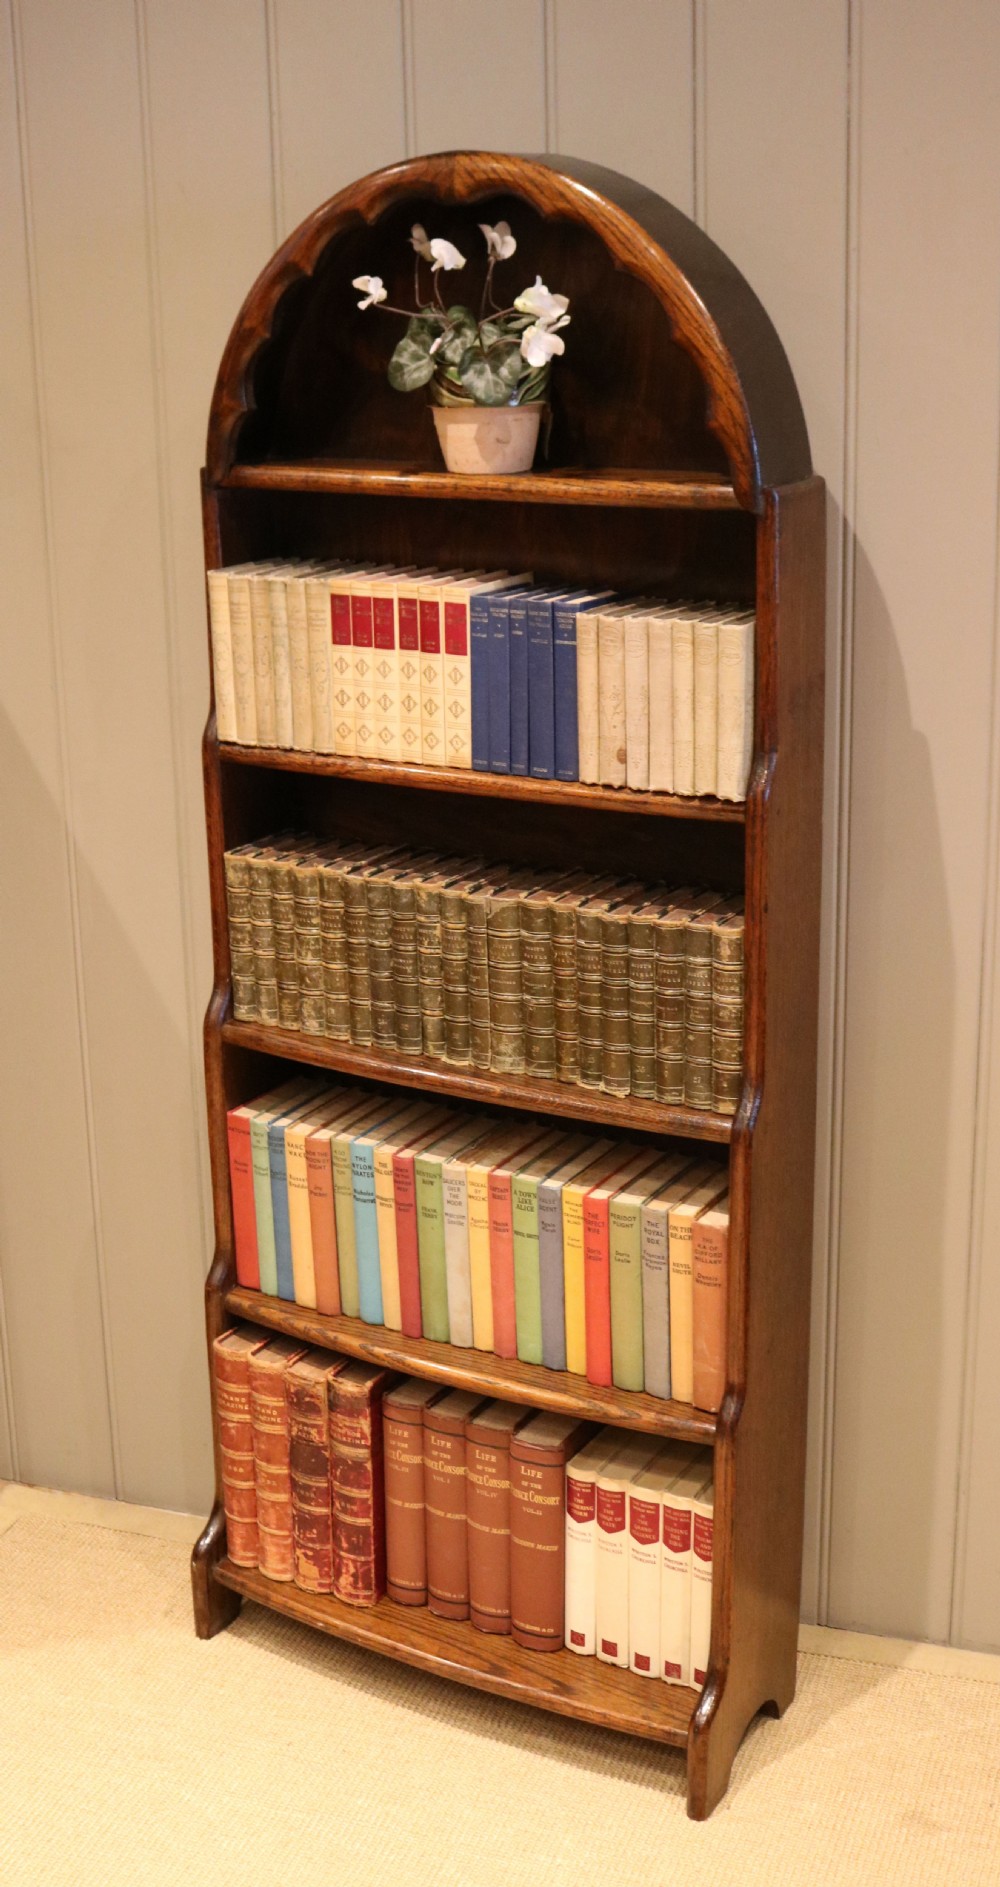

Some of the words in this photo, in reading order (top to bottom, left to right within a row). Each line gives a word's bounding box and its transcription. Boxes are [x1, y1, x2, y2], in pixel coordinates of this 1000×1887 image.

[287, 1142, 306, 1151] NANC
[646, 1221, 660, 1229] THE
[475, 1450, 497, 1463] LIFE
[521, 1465, 543, 1479] LIFE
